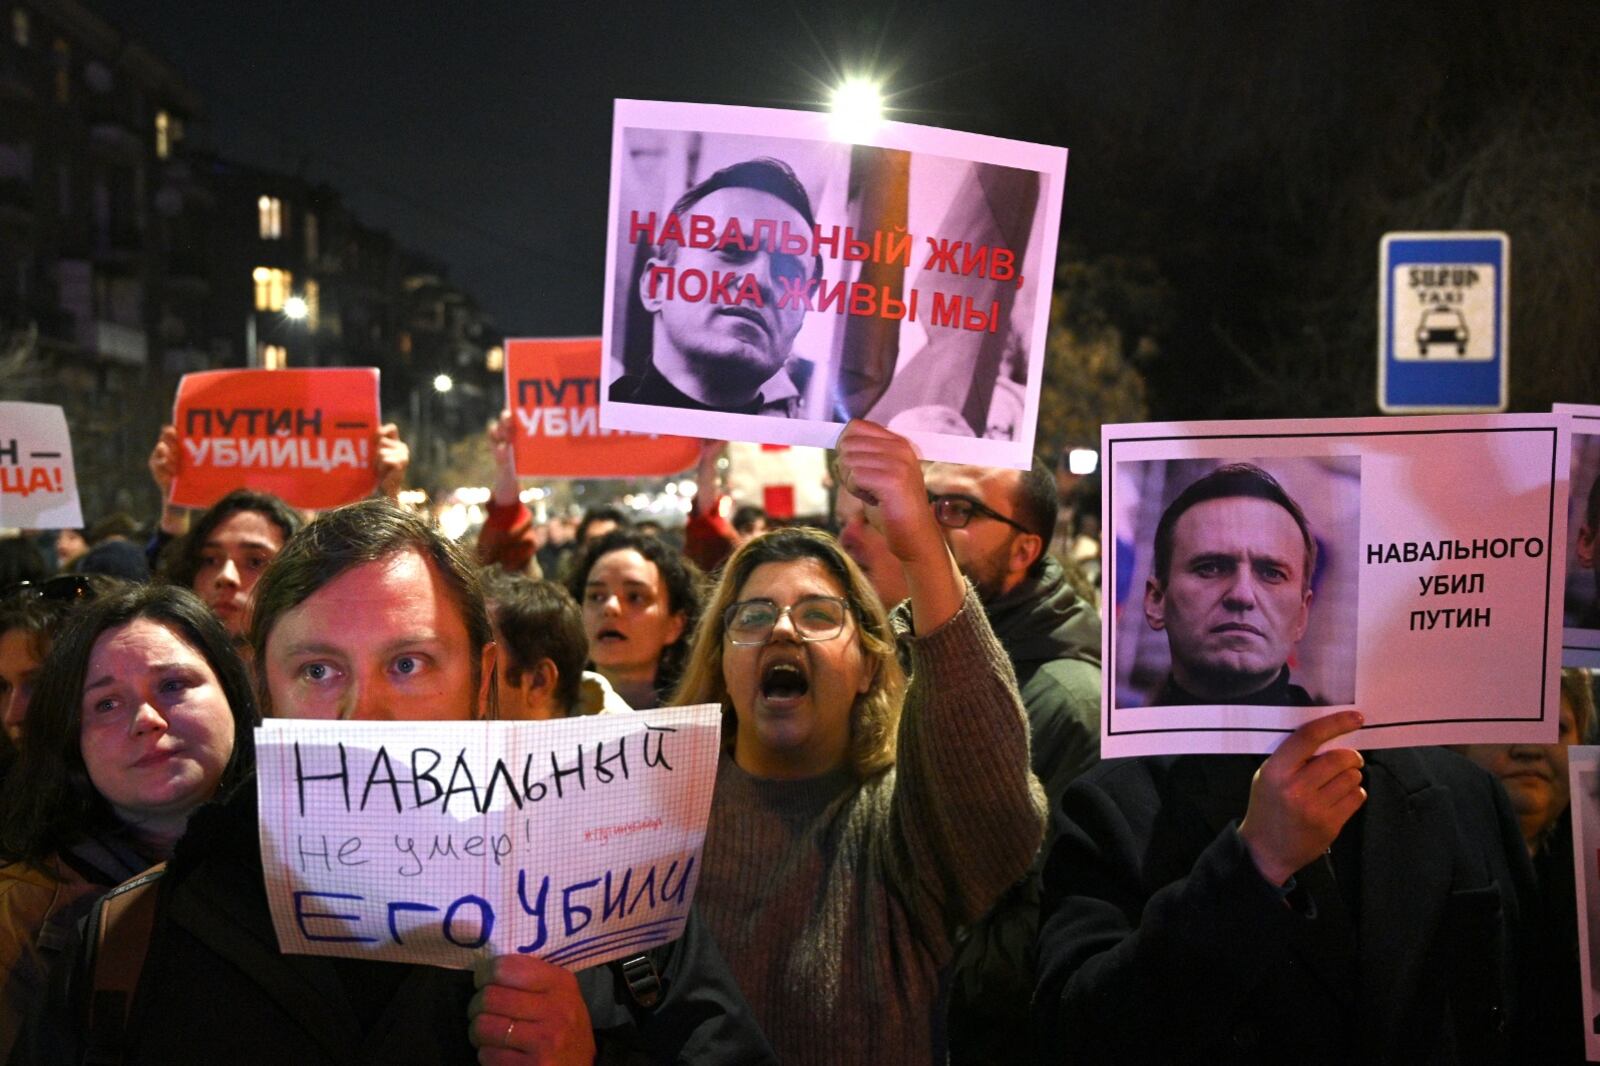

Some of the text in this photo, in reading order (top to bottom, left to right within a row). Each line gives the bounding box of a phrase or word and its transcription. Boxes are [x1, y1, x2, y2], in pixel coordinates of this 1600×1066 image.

[628, 210, 1025, 289] НАВАЛЬНЫЙ ЖИВ,
[648, 266, 999, 333] ПОКА ЖИВЫ МЫ
[185, 408, 322, 436] ПУТИН
[183, 430, 369, 472] УБИЙЦА!
[1367, 538, 1544, 564] НАВАЛЬНОГО
[1419, 573, 1485, 596] УБИЛ
[1410, 607, 1491, 630] ПУТИН
[394, 819, 532, 876] умер!
[294, 857, 695, 953] ЕГО УБИЛИ
